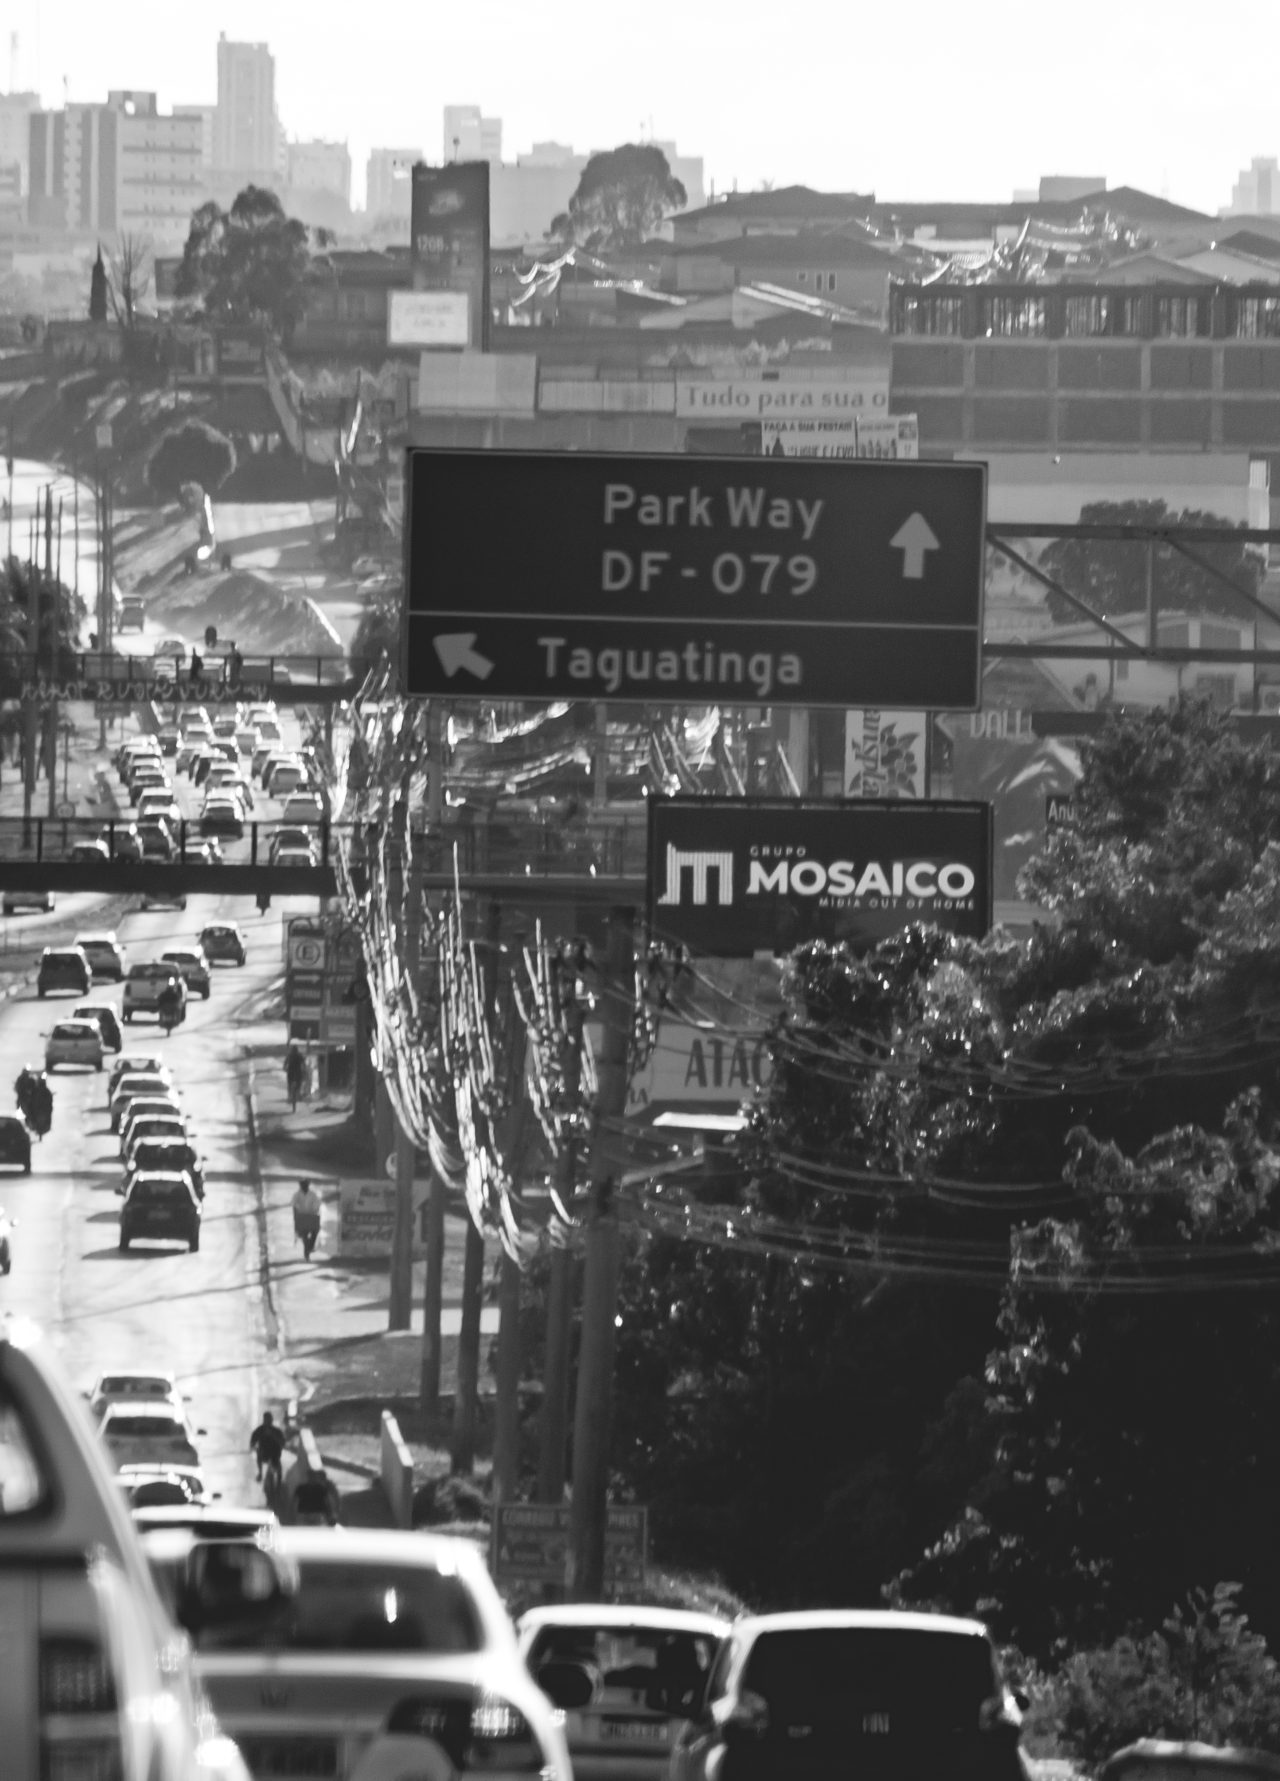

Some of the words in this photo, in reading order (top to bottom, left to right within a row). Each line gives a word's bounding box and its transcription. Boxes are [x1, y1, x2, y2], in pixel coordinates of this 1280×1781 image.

[686, 385, 751, 408] Tudo
[758, 391, 814, 414] para
[821, 391, 864, 408] sua
[603, 483, 713, 527] Park
[726, 487, 823, 541] Way
[537, 637, 802, 697] Taguatinga
[750, 845, 807, 858] GRUPO
[745, 860, 975, 899] MOSAICO
[869, 898, 898, 909] OUT
[906, 898, 923, 910] OF
[933, 899, 975, 911] HOME
